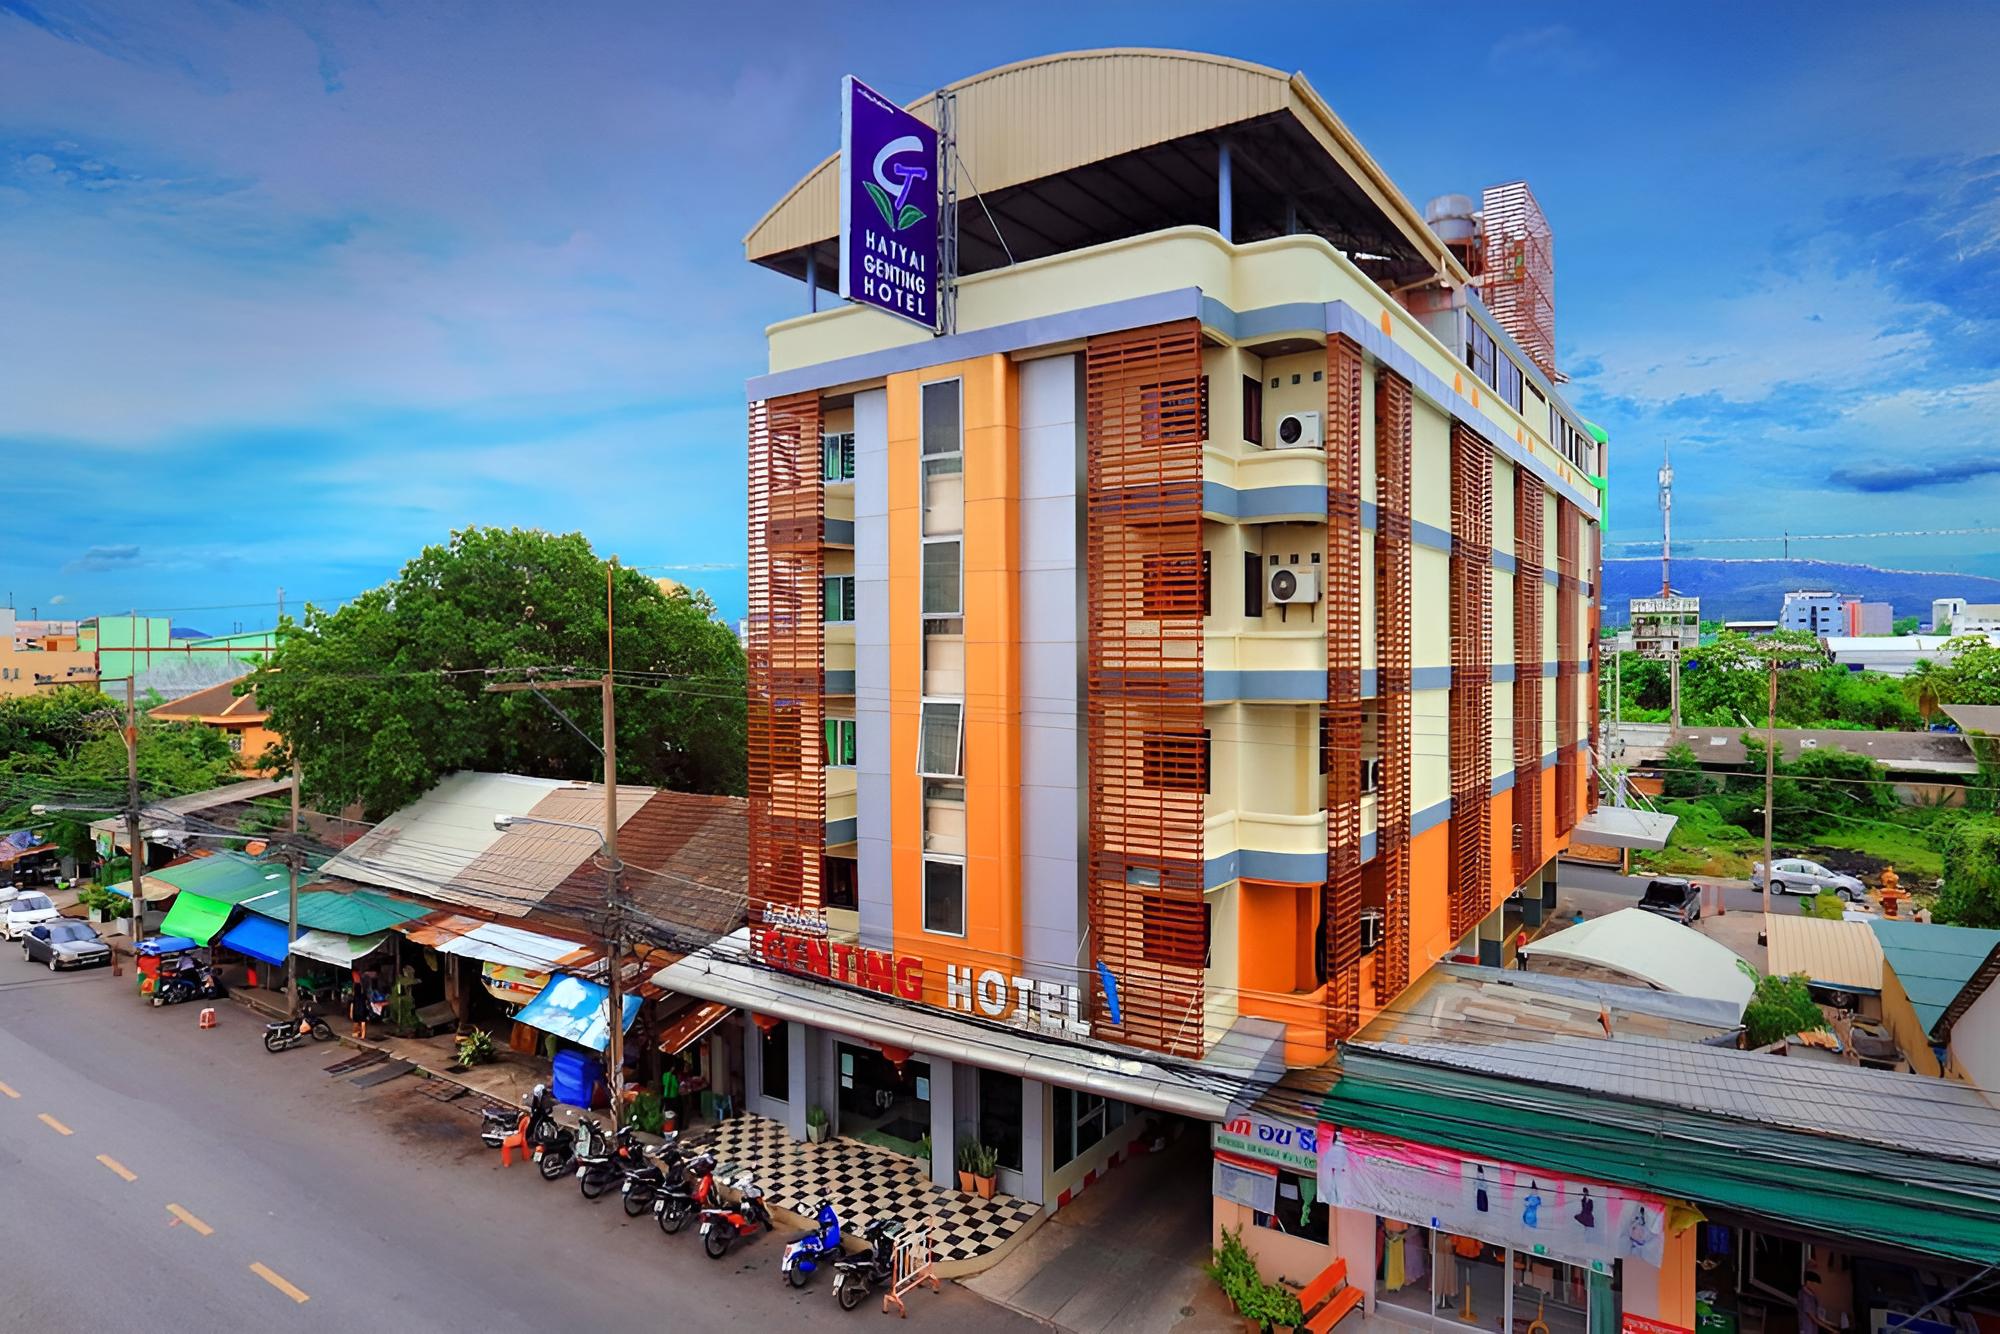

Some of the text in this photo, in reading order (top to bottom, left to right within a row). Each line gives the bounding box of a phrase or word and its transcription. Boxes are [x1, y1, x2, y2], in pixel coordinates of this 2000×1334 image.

[865, 228, 925, 273] HATYAI
[863, 254, 926, 295] GENTING
[864, 275, 926, 316] HOTEL
[762, 929, 1091, 1037] GENTING HOTEL
